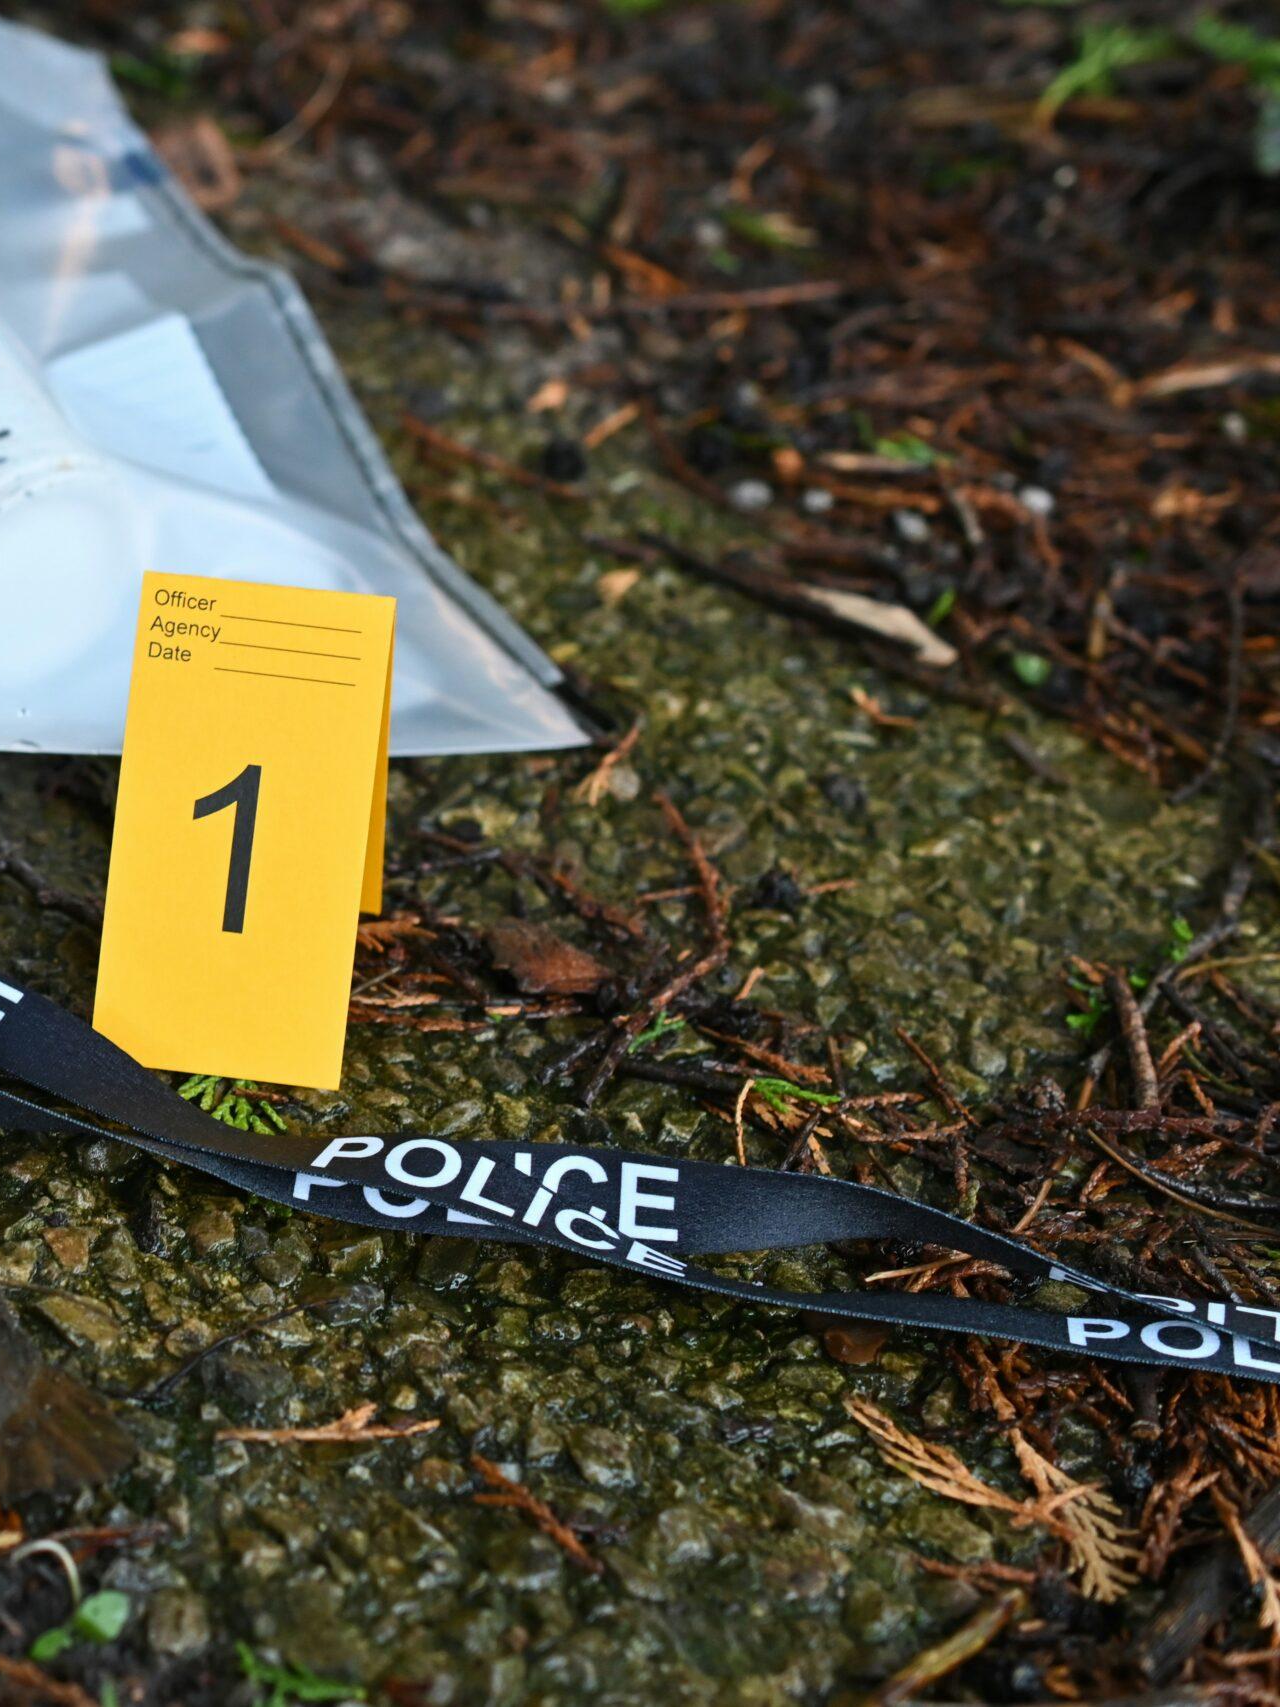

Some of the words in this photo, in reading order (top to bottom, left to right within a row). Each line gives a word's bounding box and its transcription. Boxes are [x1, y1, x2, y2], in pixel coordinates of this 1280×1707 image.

[154, 588, 218, 611] Officer
[150, 615, 221, 643] Agency
[148, 641, 192, 662] Date
[192, 764, 262, 934] 1
[311, 1136, 688, 1277] POLICE
